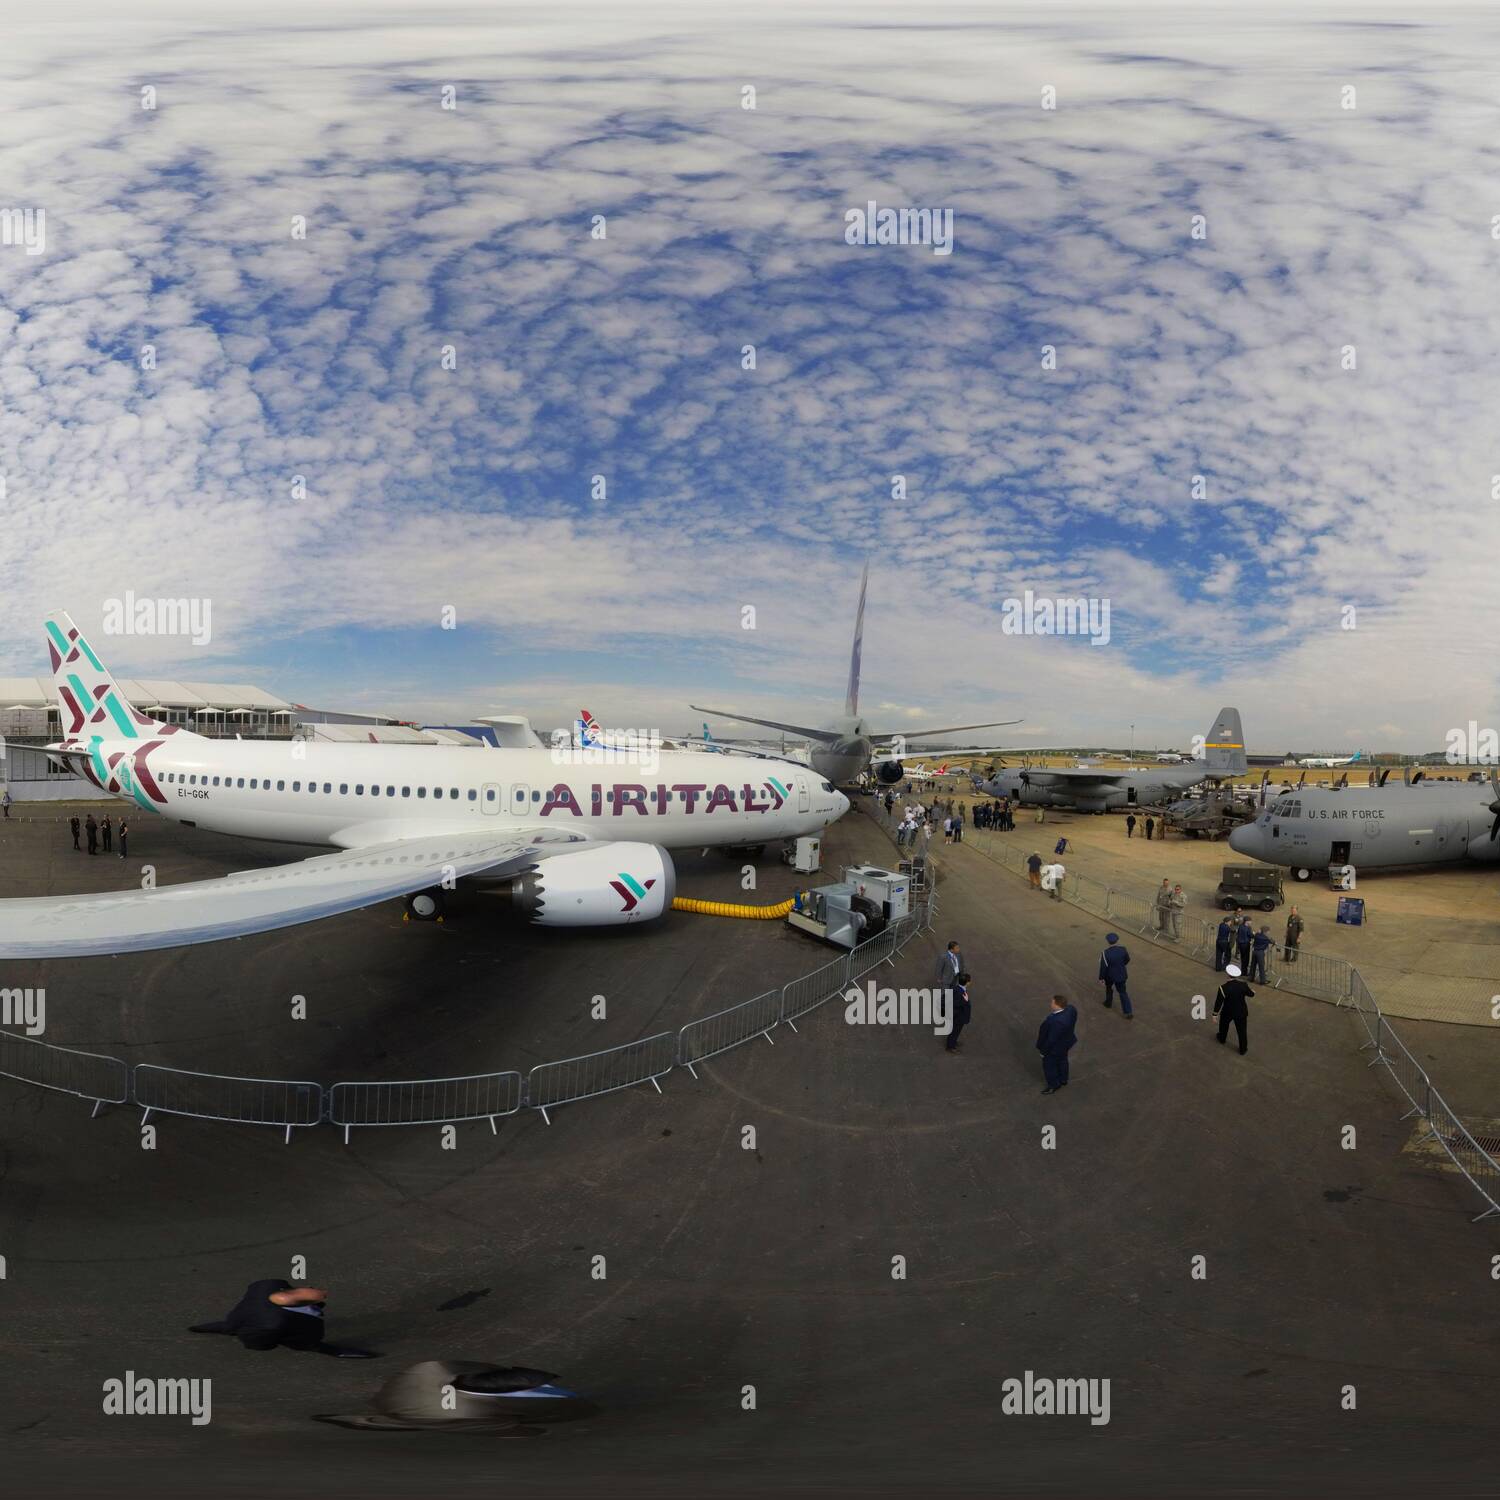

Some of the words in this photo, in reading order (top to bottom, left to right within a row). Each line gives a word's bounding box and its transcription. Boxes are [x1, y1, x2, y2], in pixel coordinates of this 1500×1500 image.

[178, 788, 209, 799] EI-GGK
[1308, 810, 1330, 819] U.S.
[1332, 809, 1348, 819] AIR
[1352, 809, 1385, 819] FORCE
